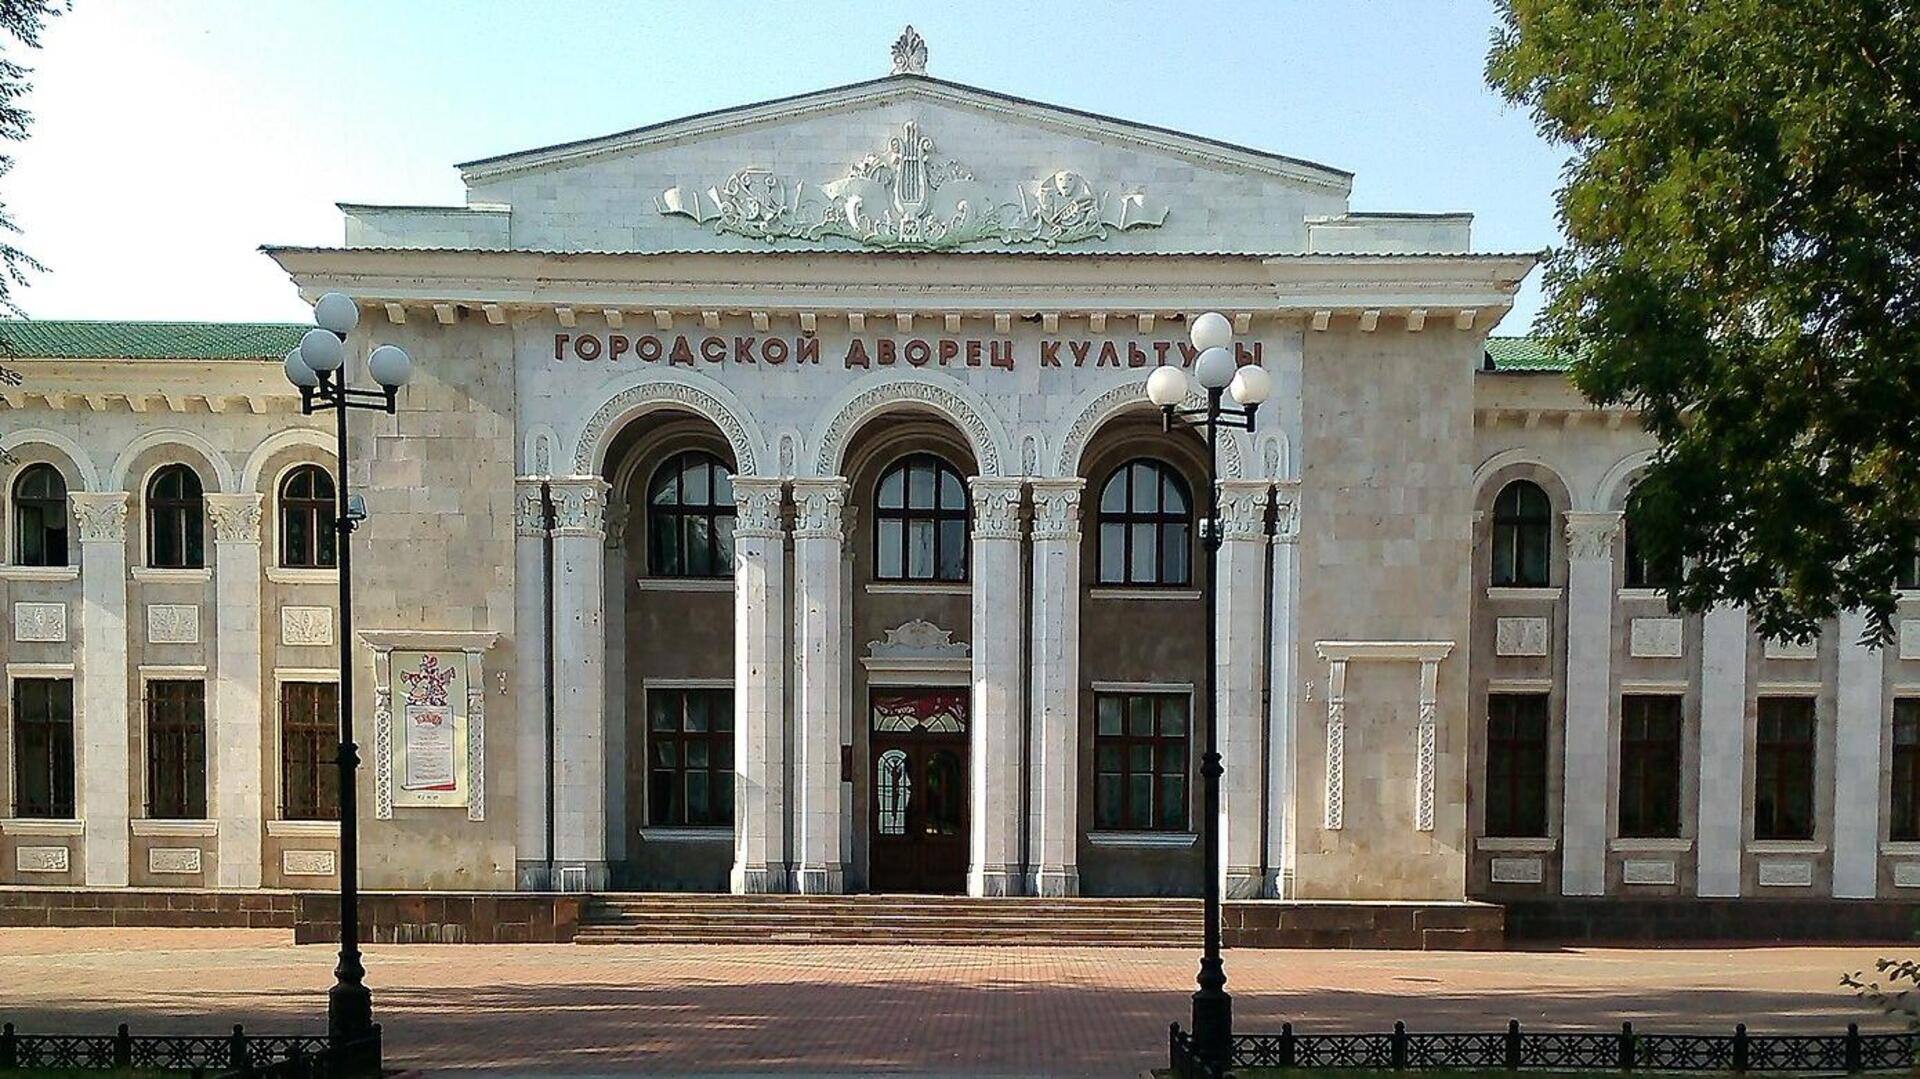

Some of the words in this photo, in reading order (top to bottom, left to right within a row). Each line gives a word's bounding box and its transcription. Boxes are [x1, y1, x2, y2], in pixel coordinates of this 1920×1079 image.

[554, 331, 820, 366] ГОРОДСКОЙ
[844, 338, 1014, 370] ДВОРЕЦ
[1040, 340, 1263, 368] КУЛЬТУЫ
